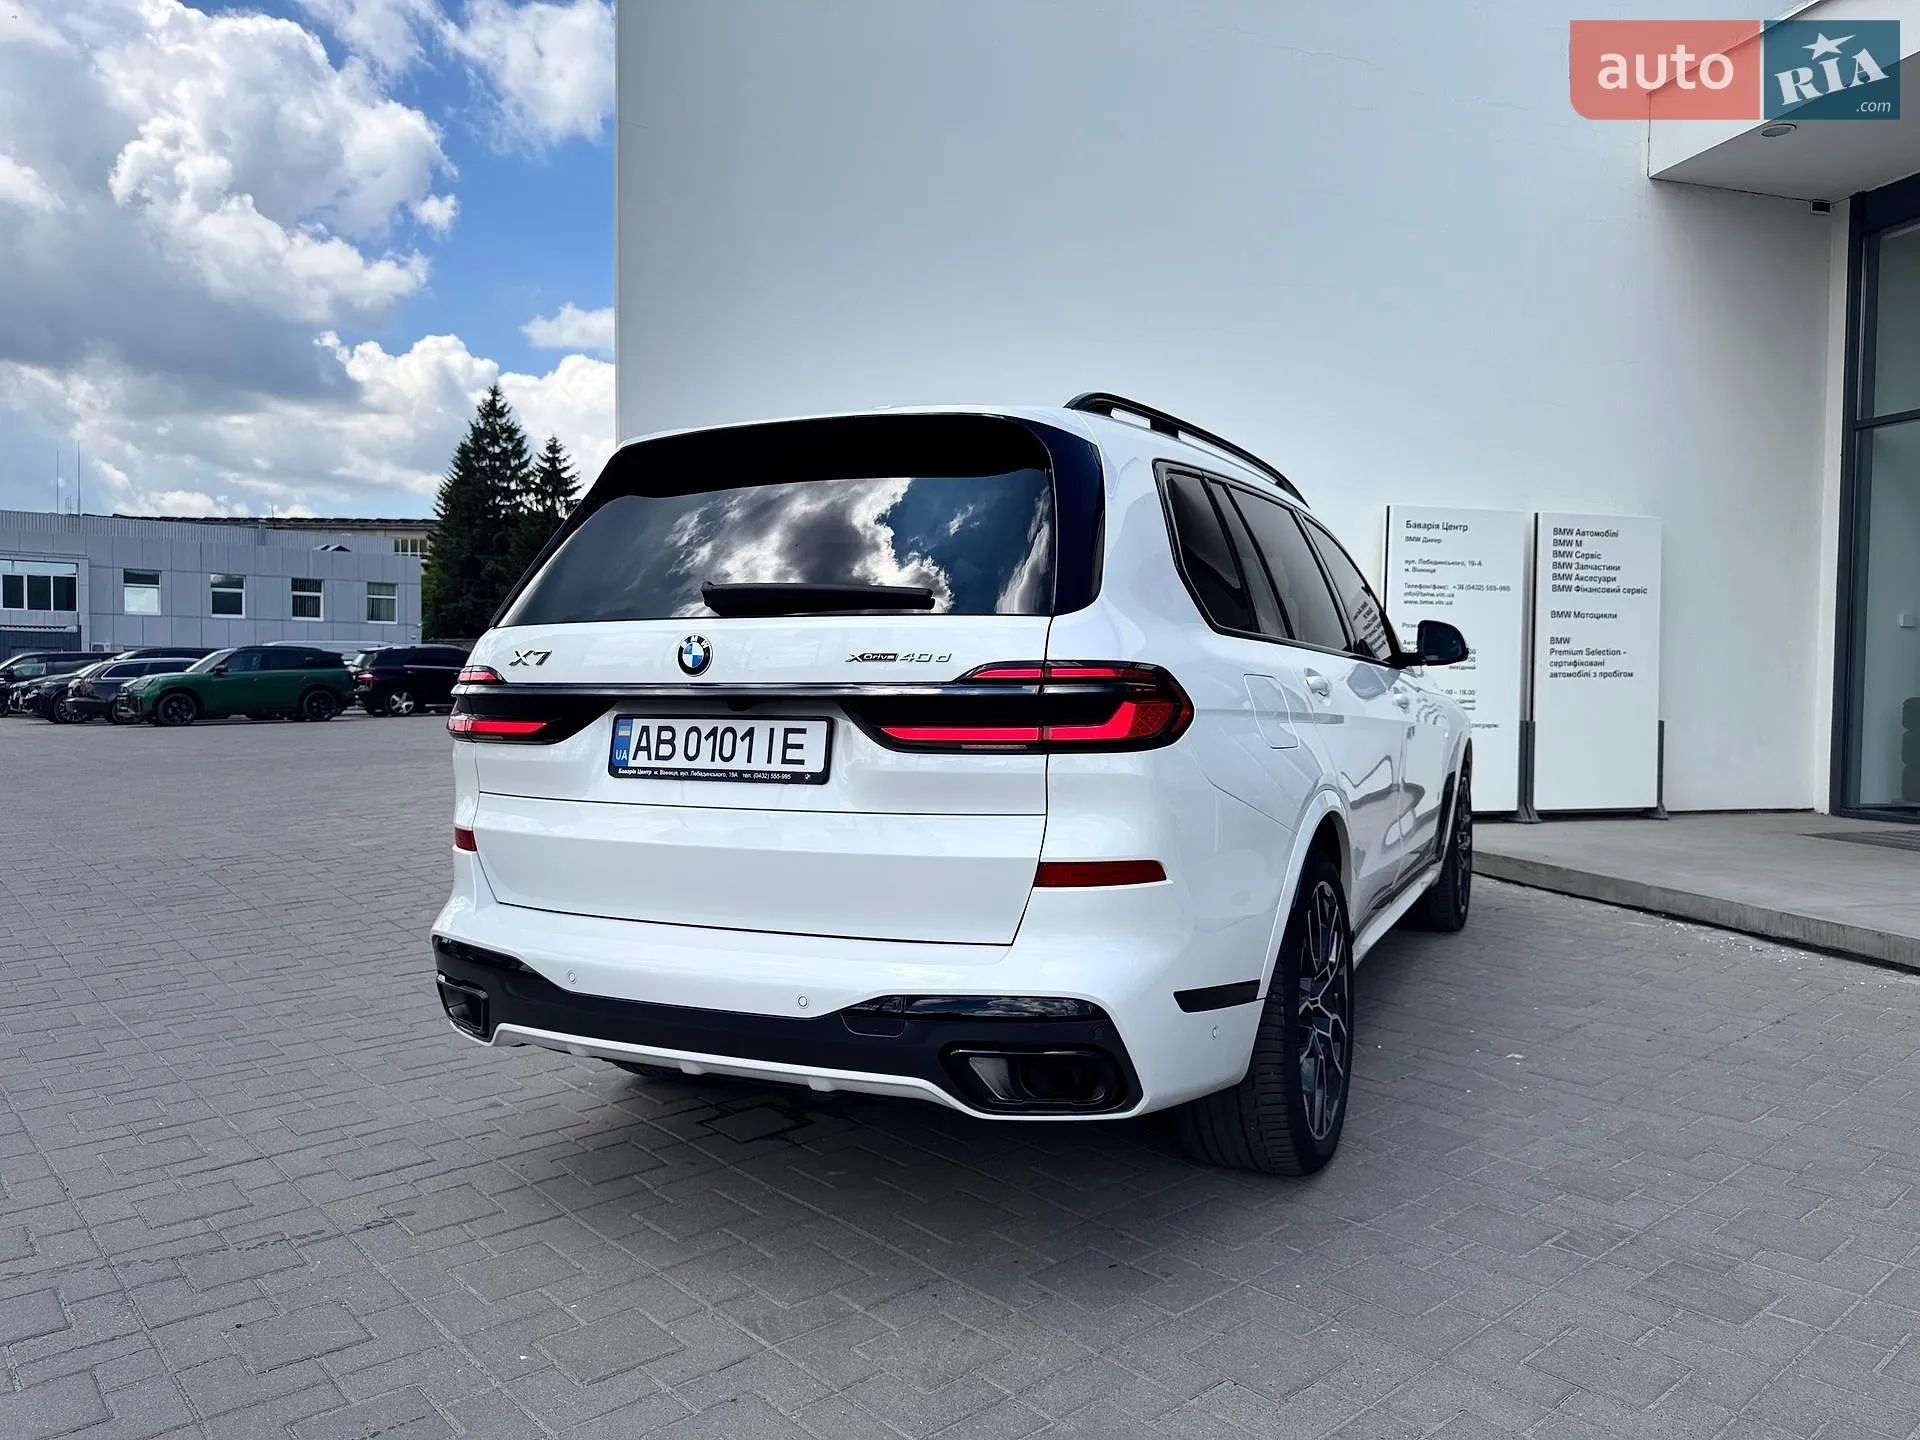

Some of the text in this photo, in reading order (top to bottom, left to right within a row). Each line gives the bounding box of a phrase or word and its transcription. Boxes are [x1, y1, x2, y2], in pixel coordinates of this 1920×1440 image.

[1405, 520, 1469, 532] Баварія Центр
[1552, 527, 1619, 538] BMW Автомобілі
[1404, 535, 1421, 543] BMW
[1552, 538, 1574, 547] BMW
[1552, 550, 1602, 560] BMW Сервіс
[1552, 561, 1621, 571] BMW Запчастини
[1551, 573, 1617, 584] BMW Аксесуари
[1551, 584, 1648, 595] BMW Фінансовий сервіс
[1550, 610, 1618, 620] BMW Мотоцикли
[680, 635, 710, 649] BMW
[1549, 636, 1571, 645] BMW
[1549, 648, 1584, 656] Premium
[1585, 648, 1621, 656] Selection
[508, 650, 553, 666] X7
[1549, 659, 1605, 668] сертифіковані
[1549, 670, 1591, 679] автомобілі
[1598, 670, 1634, 679] пробігом
[616, 750, 628, 760] UA
[753, 772, 770, 780] (0432)
